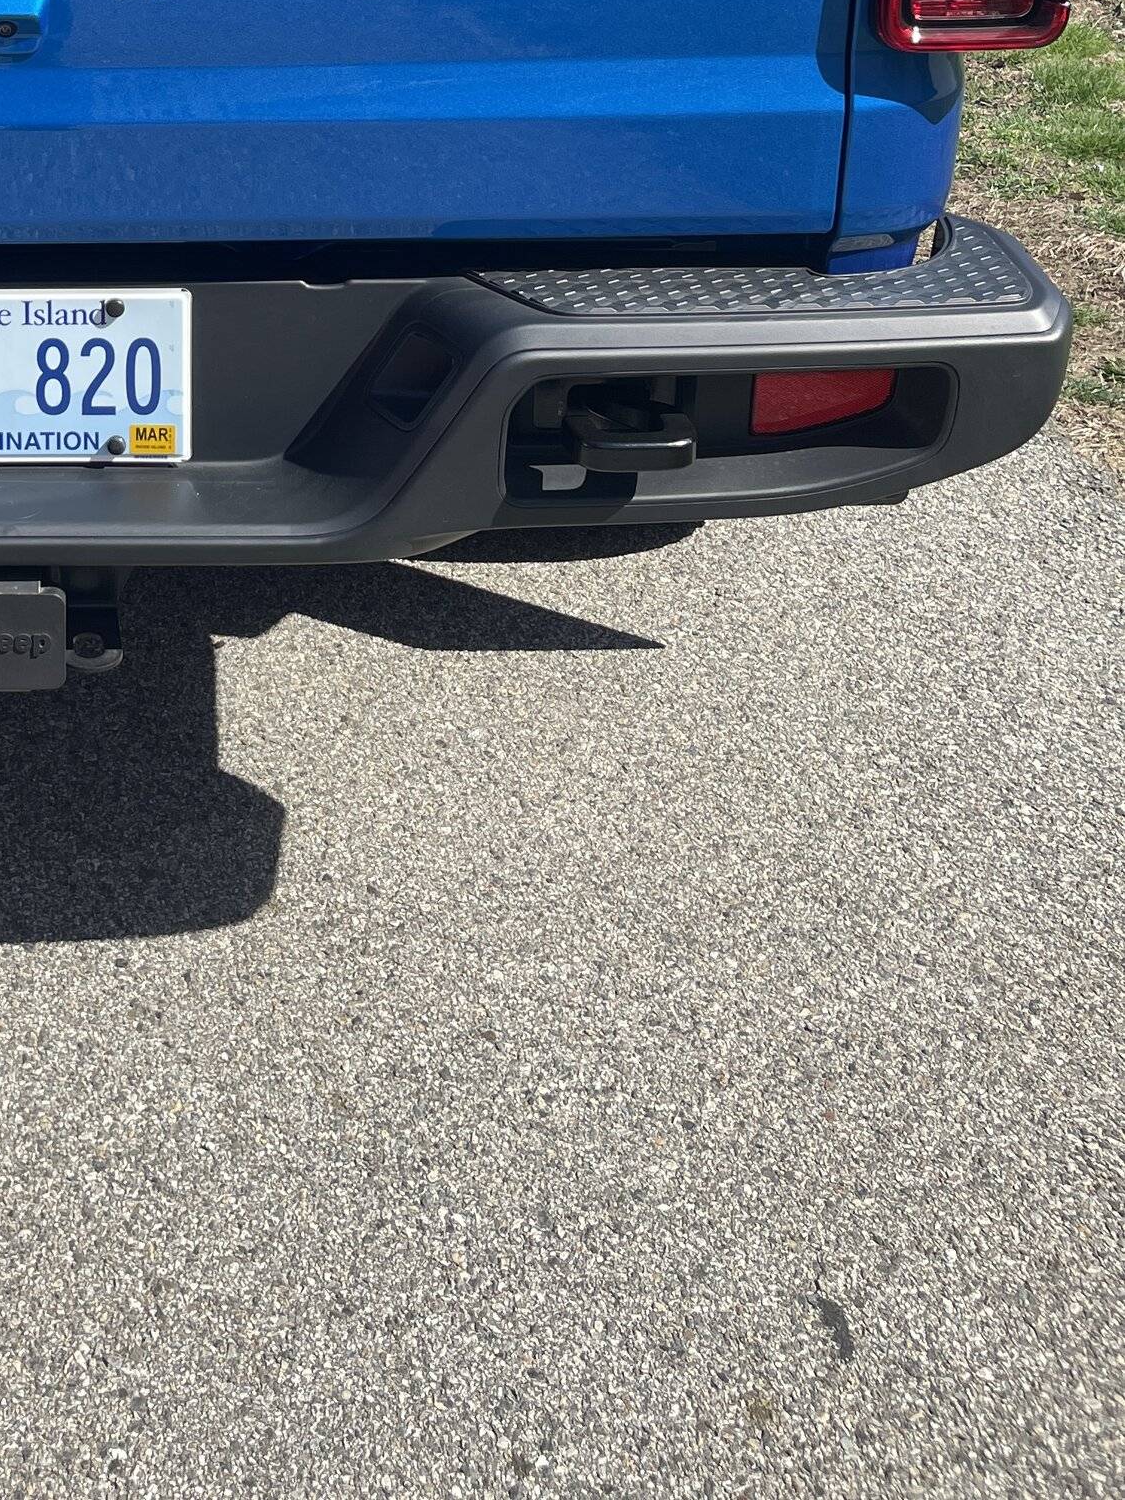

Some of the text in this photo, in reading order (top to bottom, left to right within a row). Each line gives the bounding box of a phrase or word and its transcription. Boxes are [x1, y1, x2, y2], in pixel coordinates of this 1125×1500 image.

[21, 300, 107, 327] Island
[36, 337, 162, 416] 820
[135, 427, 169, 442] MAR
